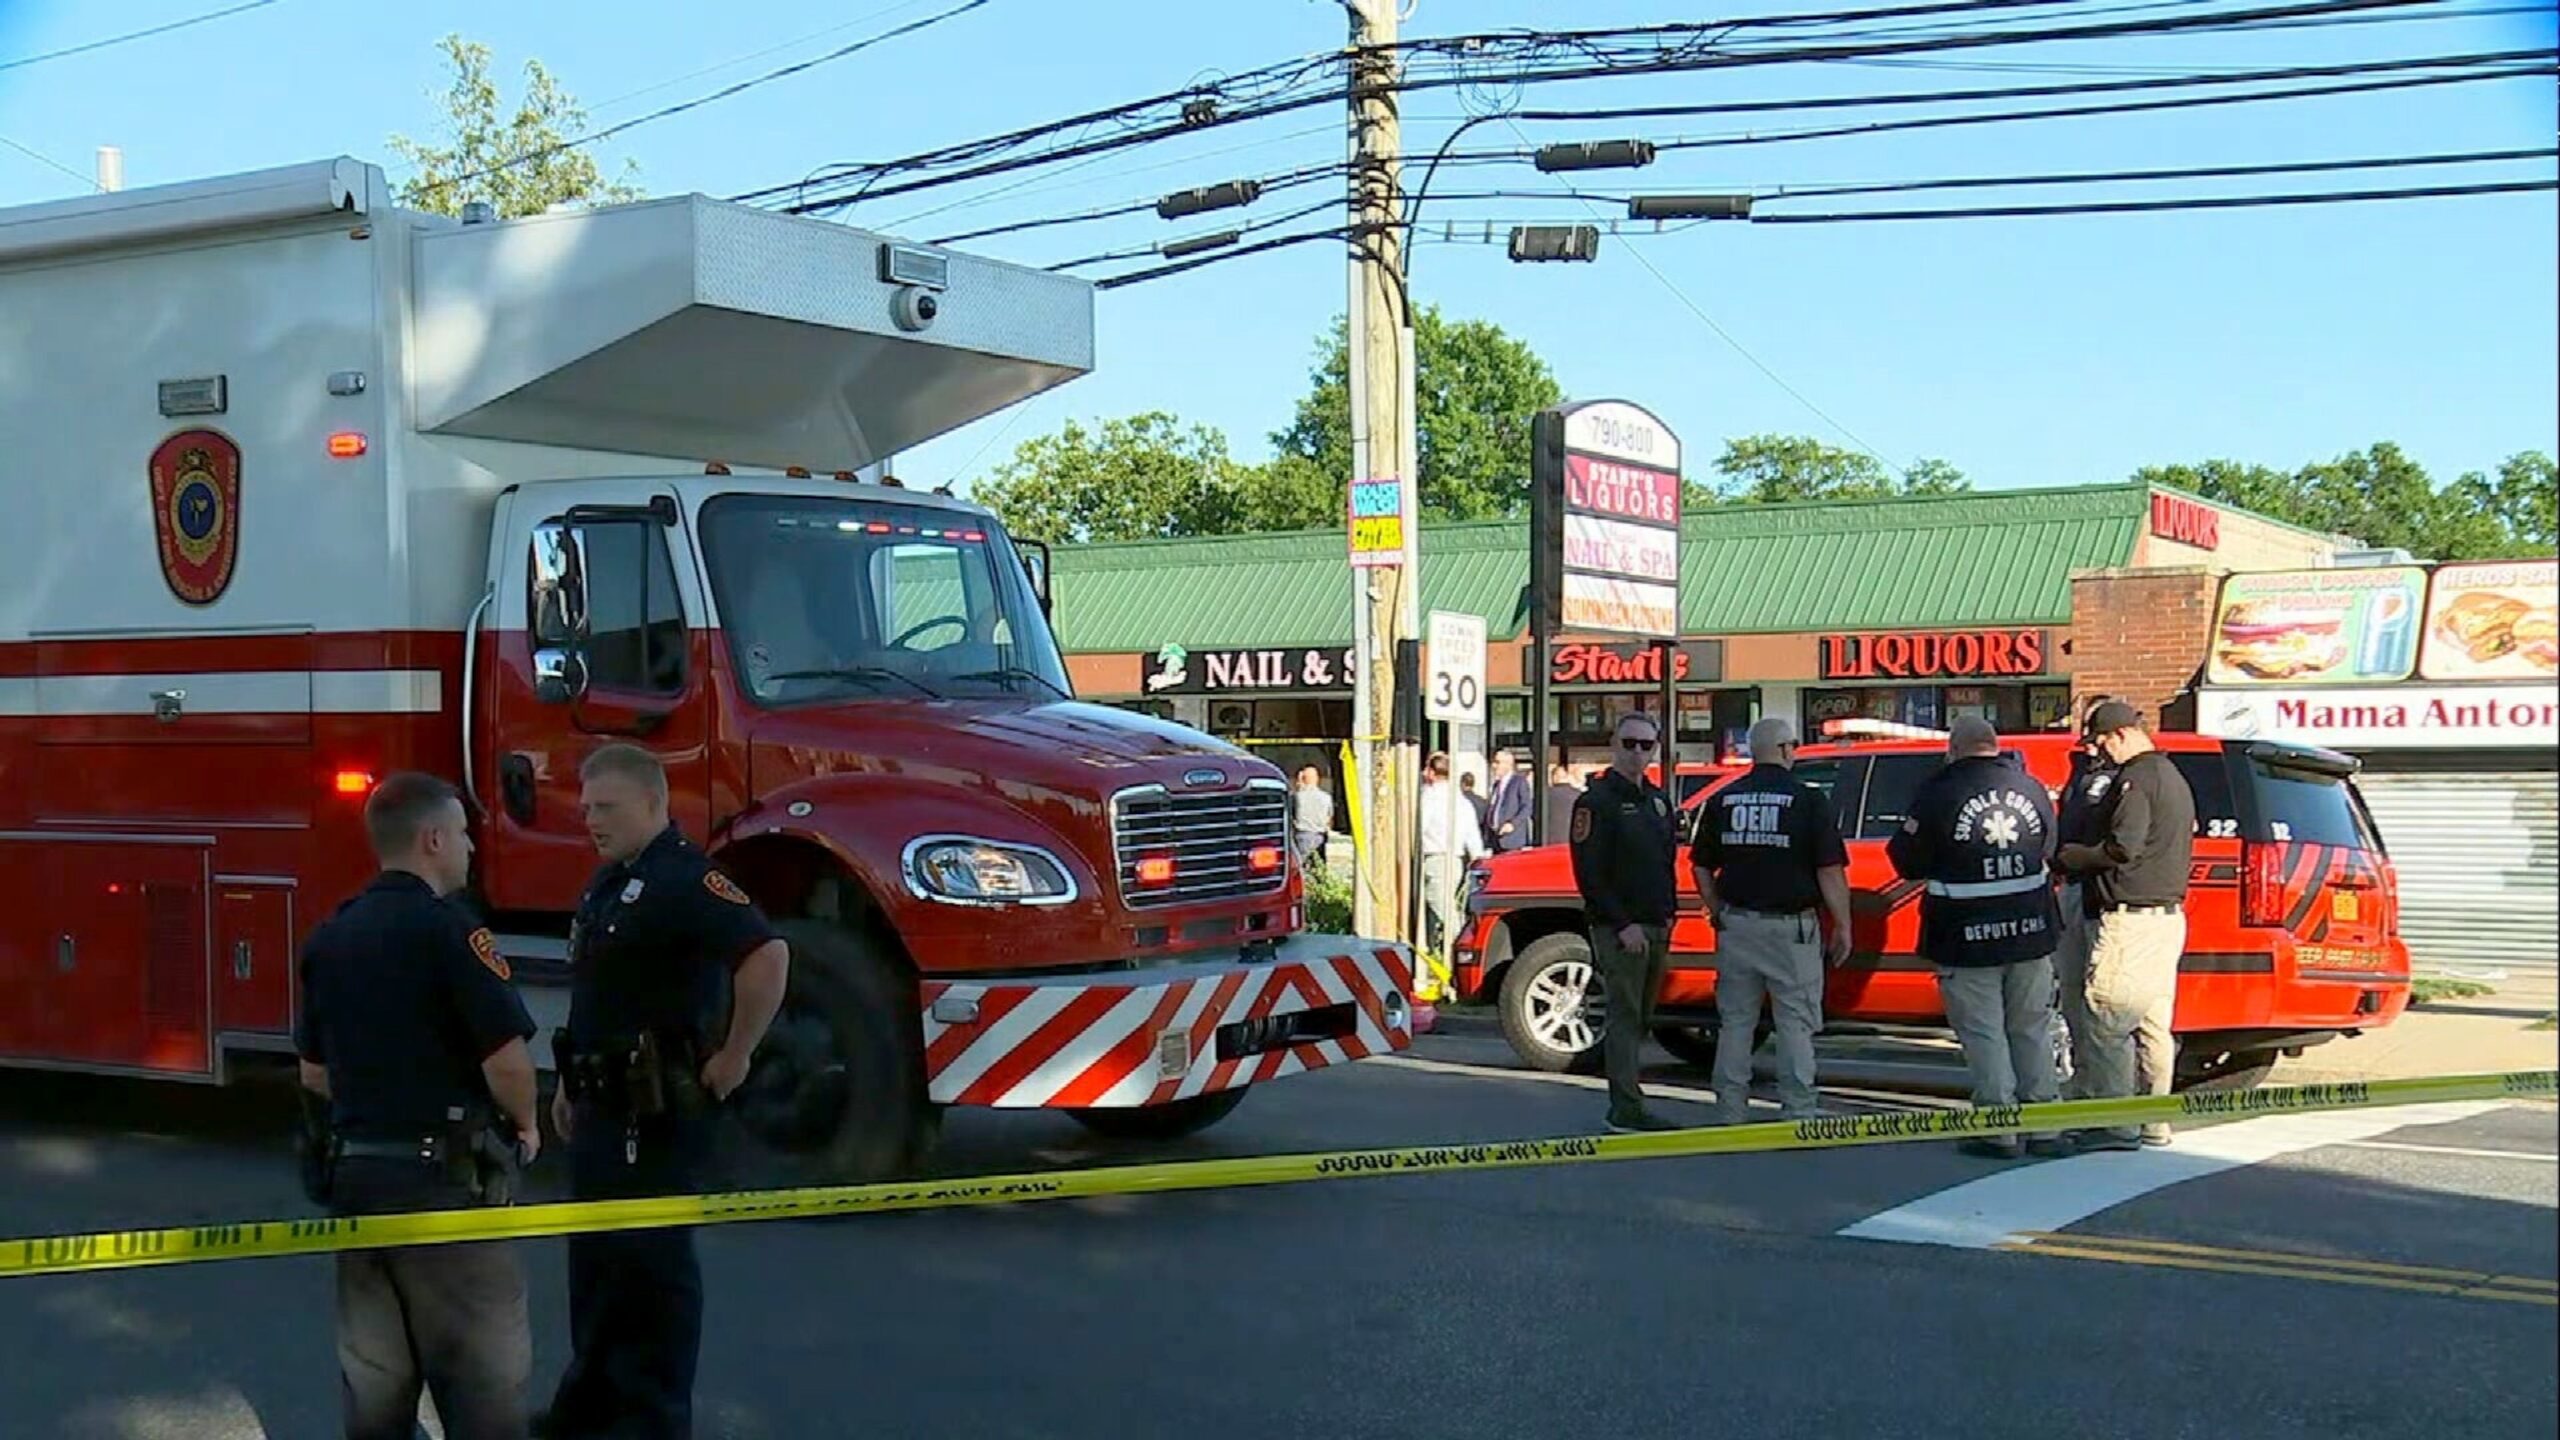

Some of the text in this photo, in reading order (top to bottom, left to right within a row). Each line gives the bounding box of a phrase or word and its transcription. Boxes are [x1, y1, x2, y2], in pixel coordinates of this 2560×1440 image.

[1592, 416, 1653, 455] 790-800
[1570, 477, 1676, 521] LIQUORS
[2151, 494, 2219, 550] LIQUORS
[1566, 536, 1613, 568] NAIL
[1639, 547, 1673, 578] SPA
[1204, 651, 1292, 688] NAIL
[1302, 650, 1333, 685] &
[1826, 629, 2043, 677] LIQUORS
[1435, 671, 1477, 710] 30
[2275, 699, 2408, 729] Mama
[1731, 805, 1779, 832] OEM
[1953, 790, 2042, 841] SUFFOLK COUNTY
[2207, 819, 2238, 838] 32
[1983, 854, 2025, 880] EMS
[1964, 919, 2017, 941] DEPUTY
